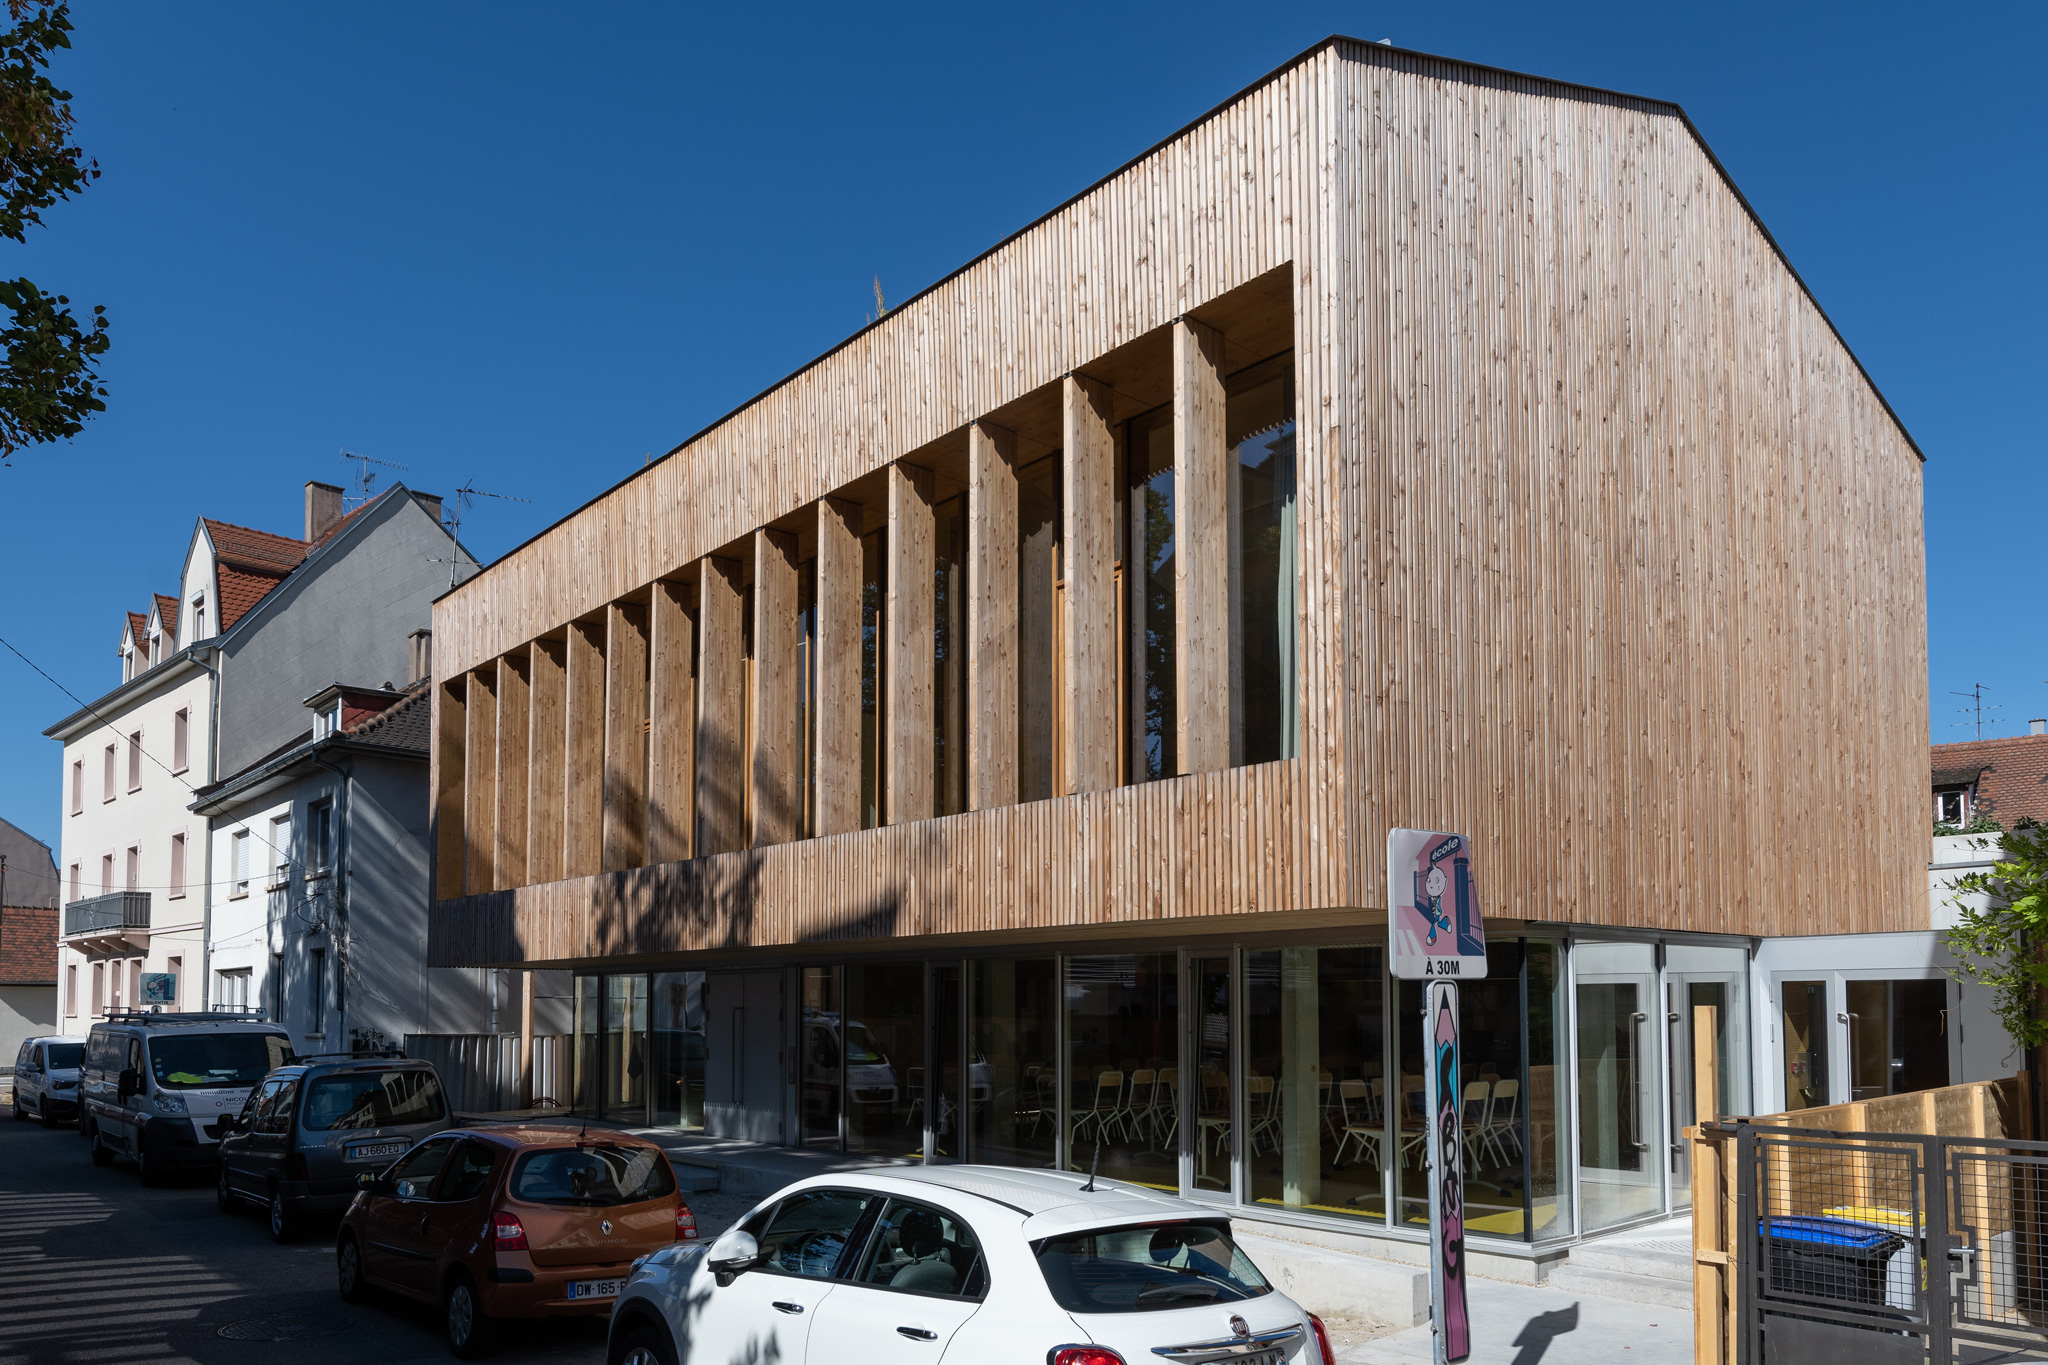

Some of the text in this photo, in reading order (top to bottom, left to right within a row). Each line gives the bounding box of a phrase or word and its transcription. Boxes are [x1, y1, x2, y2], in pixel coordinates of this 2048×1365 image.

[1432, 838, 1458, 860] école
[1426, 957, 1460, 975] À 30M
